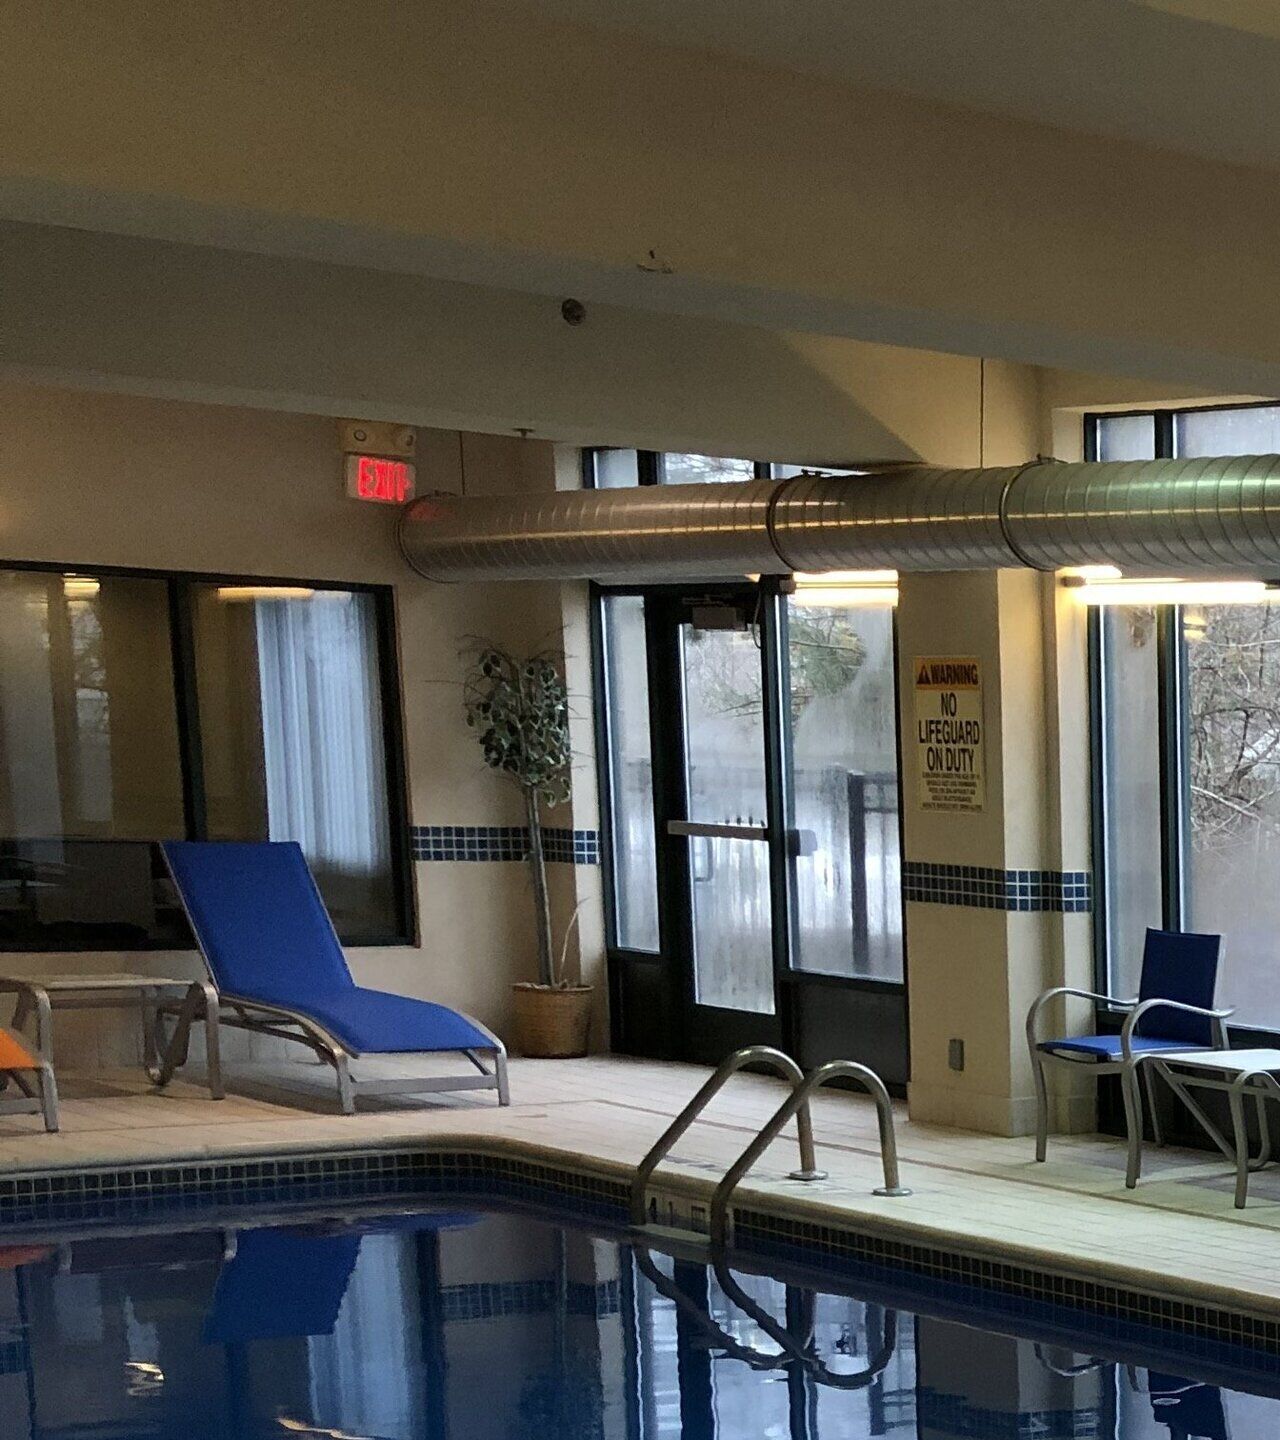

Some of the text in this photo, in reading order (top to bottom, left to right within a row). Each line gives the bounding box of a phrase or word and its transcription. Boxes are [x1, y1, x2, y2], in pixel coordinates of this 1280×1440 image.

[358, 456, 408, 501] EXIT
[930, 663, 978, 685] WARNING
[941, 692, 957, 717] NO
[918, 720, 980, 745] LIFEGUARD
[927, 746, 974, 772] ON DUTY
